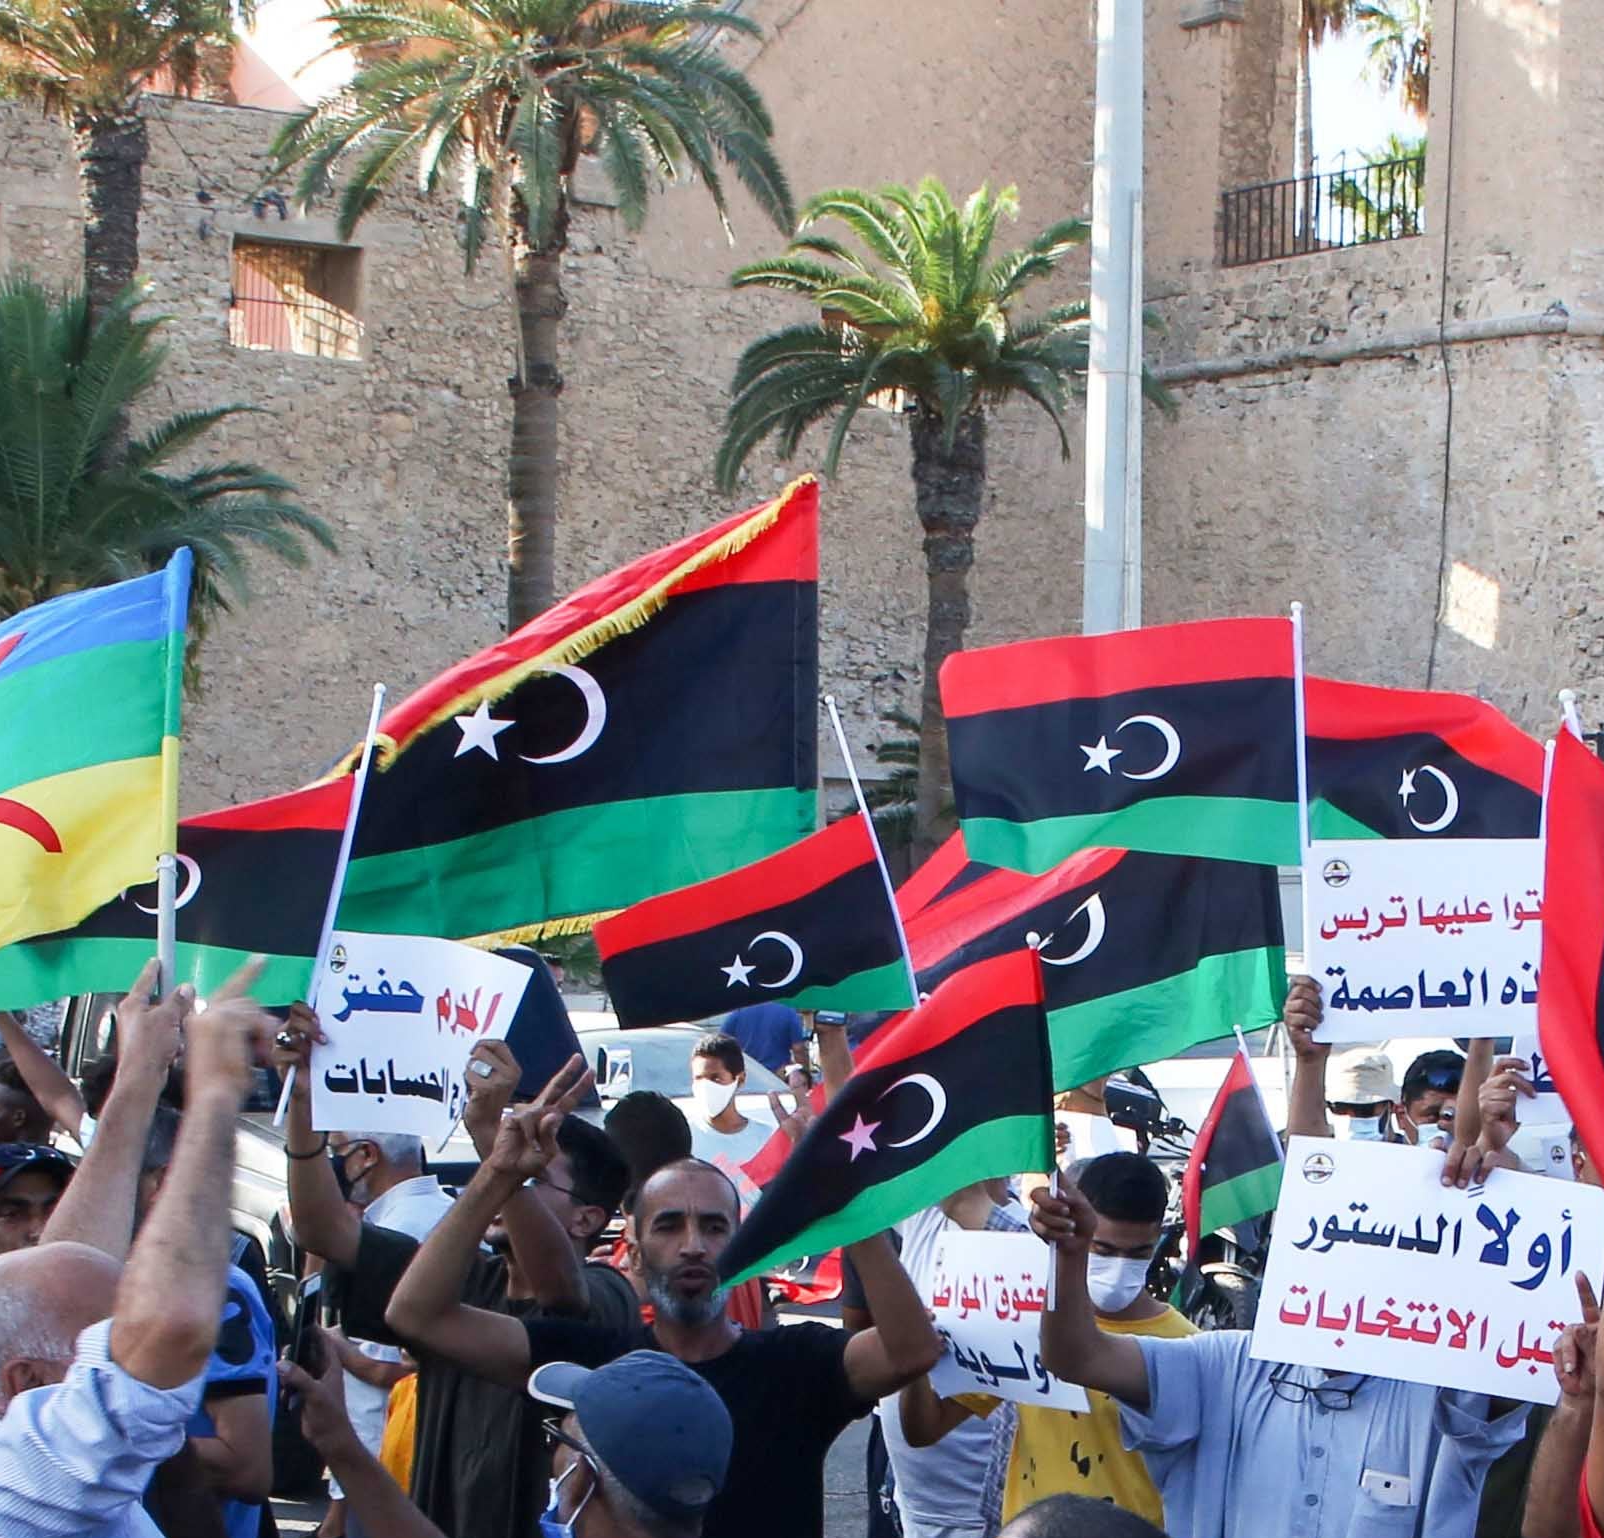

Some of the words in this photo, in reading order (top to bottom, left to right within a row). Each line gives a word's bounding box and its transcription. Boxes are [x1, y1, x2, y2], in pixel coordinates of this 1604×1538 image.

[1319, 895, 1407, 941] تريس
[1419, 894, 1493, 935] عليها
[332, 967, 425, 1023] حفتر
[1325, 965, 1488, 1013] العاصمة
[1499, 960, 1541, 1006] ذه
[1291, 1201, 1463, 1258] الدستور
[1278, 1284, 1490, 1352] الانتخابات
